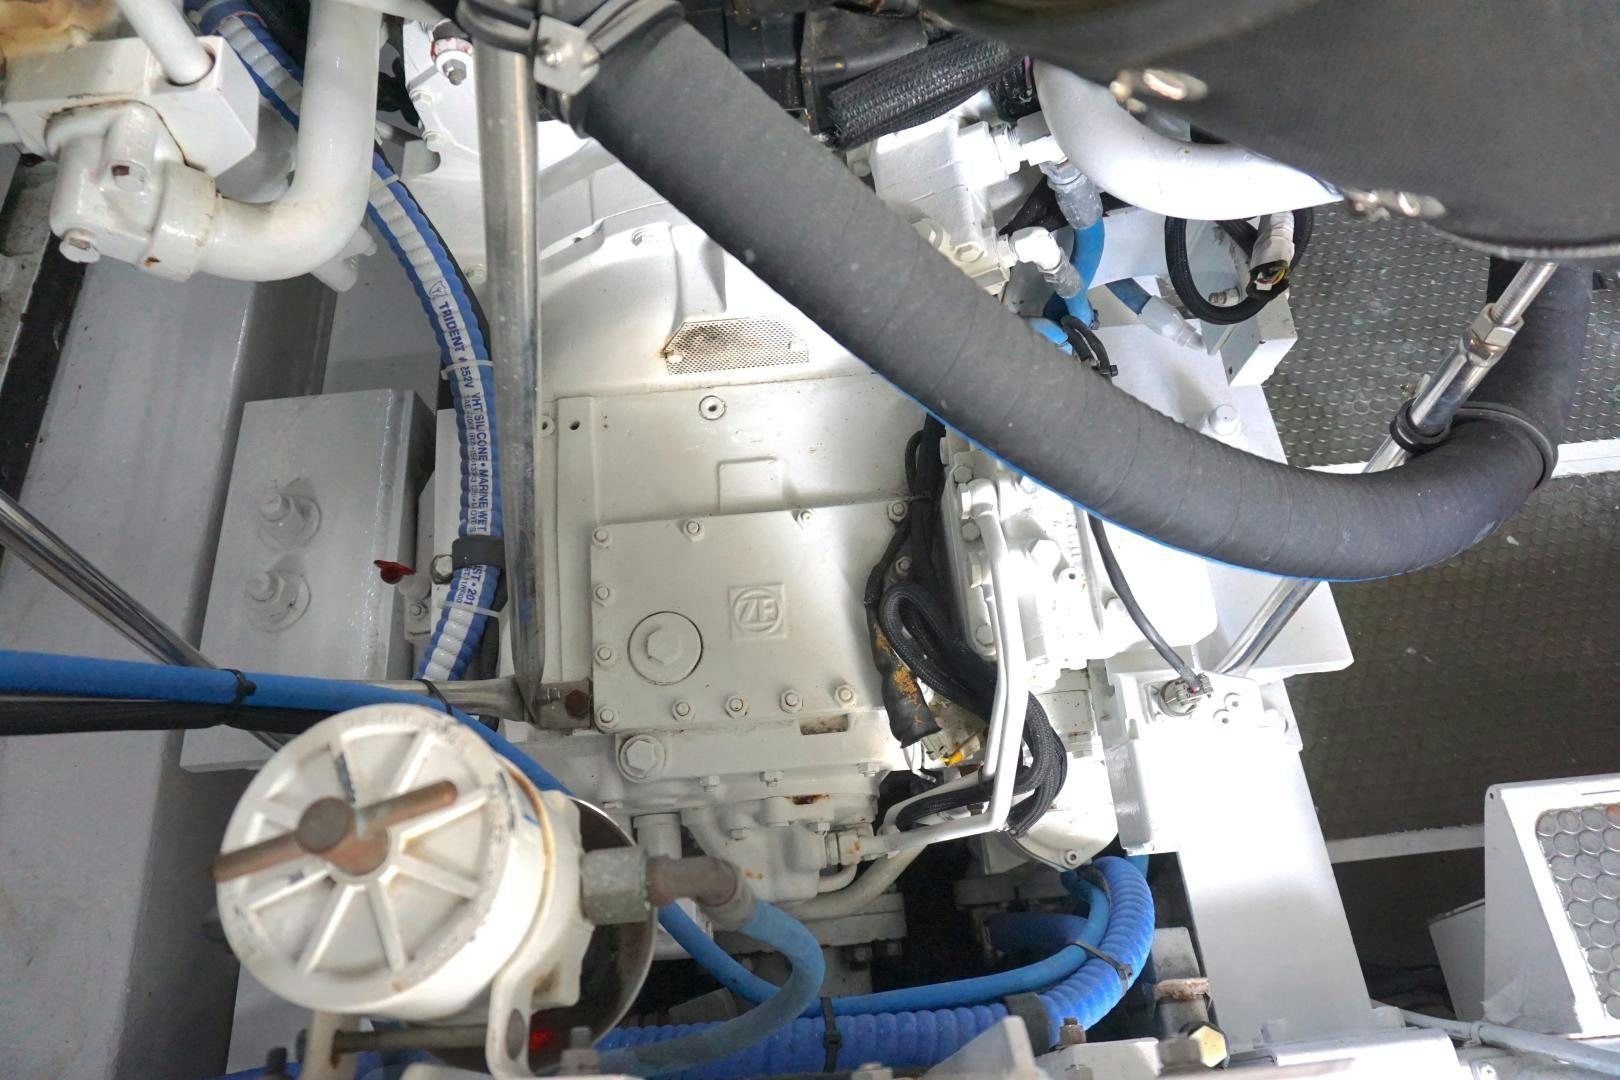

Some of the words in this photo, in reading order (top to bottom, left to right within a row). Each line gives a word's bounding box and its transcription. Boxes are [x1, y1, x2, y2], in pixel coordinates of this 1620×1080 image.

[439, 301, 466, 352] TRIDENT
[471, 392, 484, 412] VHT
[473, 414, 488, 461] SILICONE
[478, 469, 489, 508] MARINE
[478, 511, 488, 532] WET
